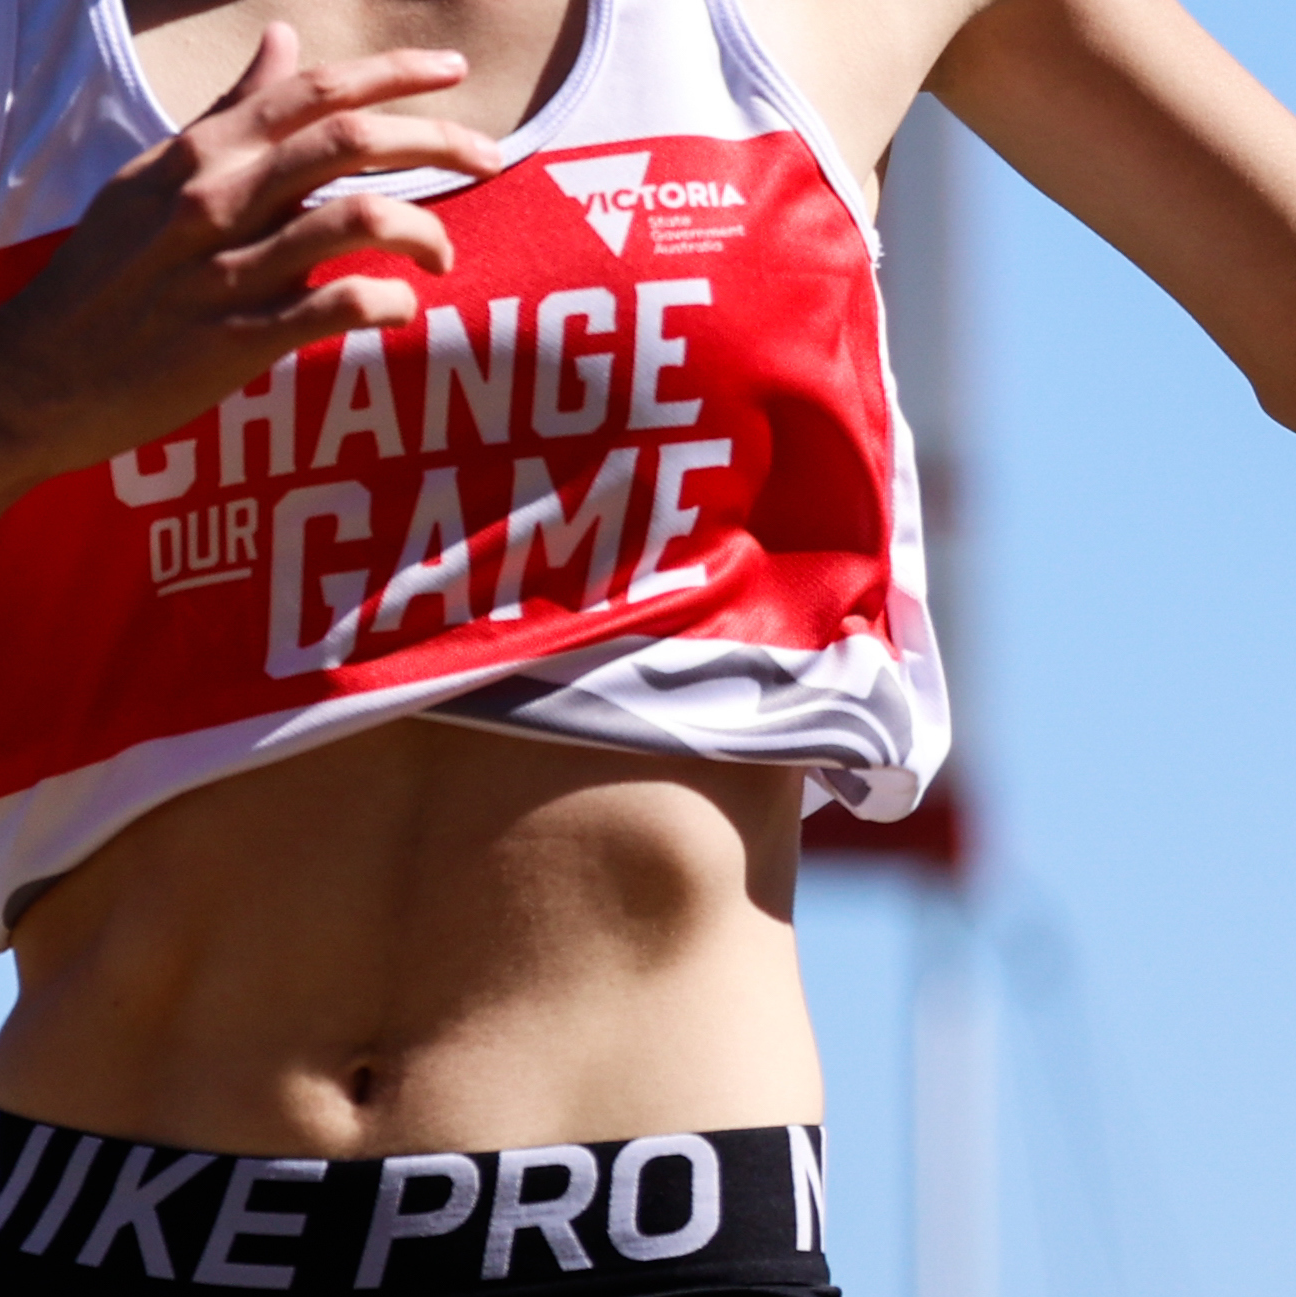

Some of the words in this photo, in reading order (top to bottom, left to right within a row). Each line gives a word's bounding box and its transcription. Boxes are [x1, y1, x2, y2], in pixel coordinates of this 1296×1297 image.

[566, 181, 746, 214] VICTORIA
[648, 215, 691, 228] State
[650, 224, 745, 242] Government
[654, 240, 723, 255] Australia
[149, 497, 258, 583] OUR
[264, 438, 732, 680] GAME
[353, 1133, 721, 1291] PRO
